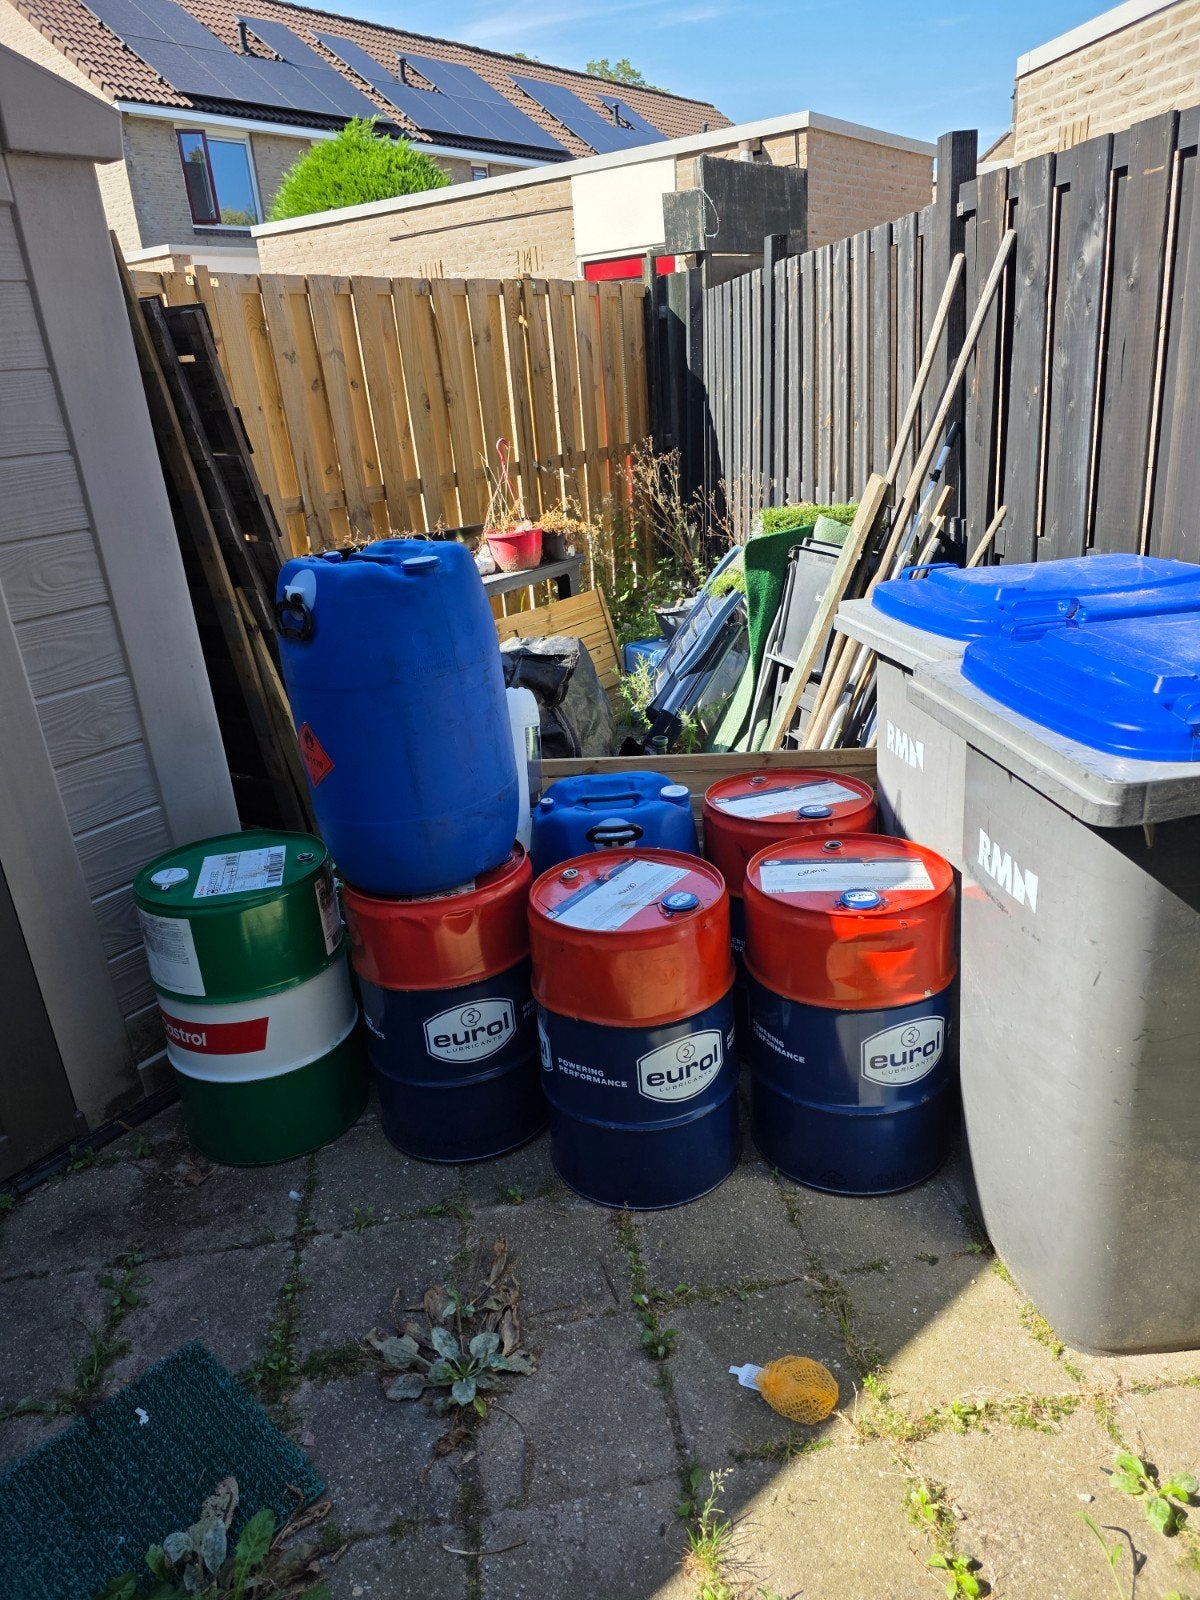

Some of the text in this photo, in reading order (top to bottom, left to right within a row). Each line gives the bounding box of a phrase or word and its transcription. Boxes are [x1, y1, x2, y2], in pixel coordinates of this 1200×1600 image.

[886, 719, 925, 773] RMN
[978, 827, 1039, 914] RMN
[433, 1011, 510, 1048] eurol
[446, 1035, 502, 1054] LUBRICANTS
[646, 1043, 718, 1086] eurol
[869, 1031, 940, 1070] eurol
[557, 1057, 605, 1077] POWERING
[558, 1064, 628, 1088] PERFORMANCE
[659, 1069, 712, 1092] LUBRICANTS
[881, 1056, 934, 1076] LUBRICANTS
